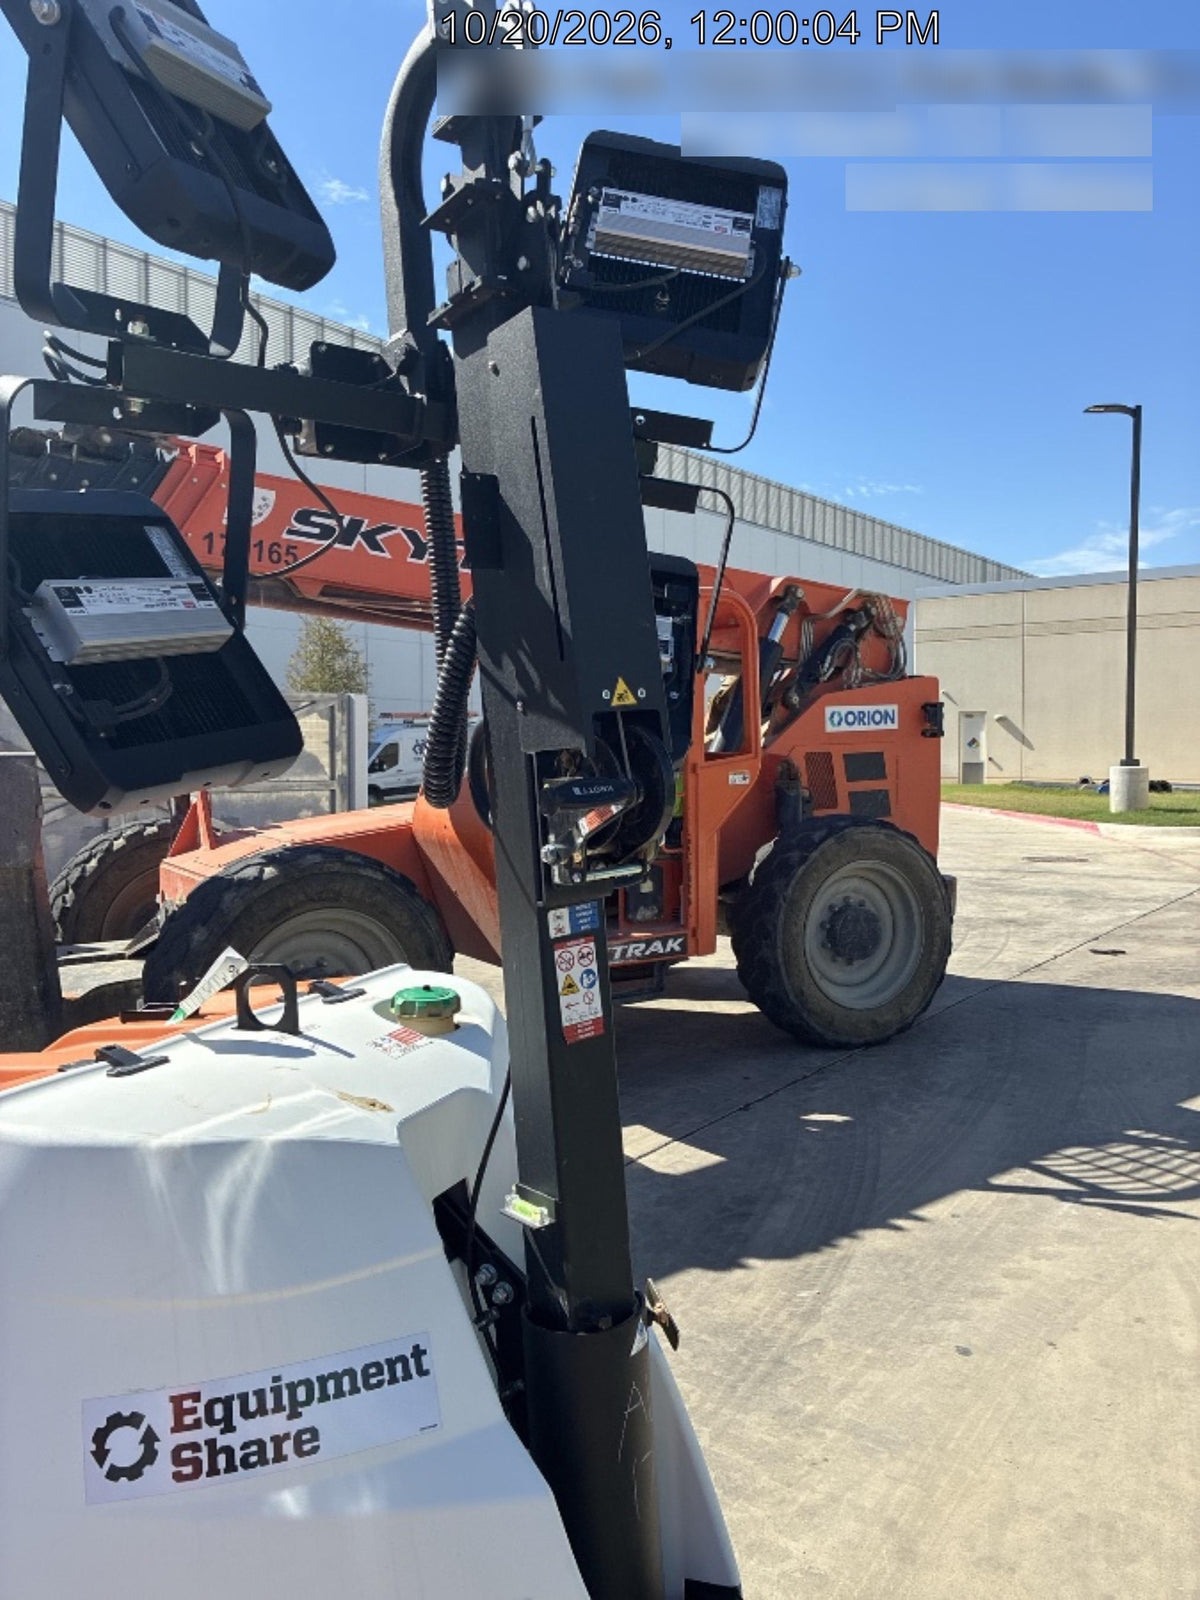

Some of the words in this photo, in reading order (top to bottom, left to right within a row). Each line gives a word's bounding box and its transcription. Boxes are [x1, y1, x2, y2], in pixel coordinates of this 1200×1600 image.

[844, 708, 896, 727] ORION
[608, 936, 684, 960] TRAK
[168, 1343, 431, 1435] Equipment
[170, 1425, 321, 1483] Share
